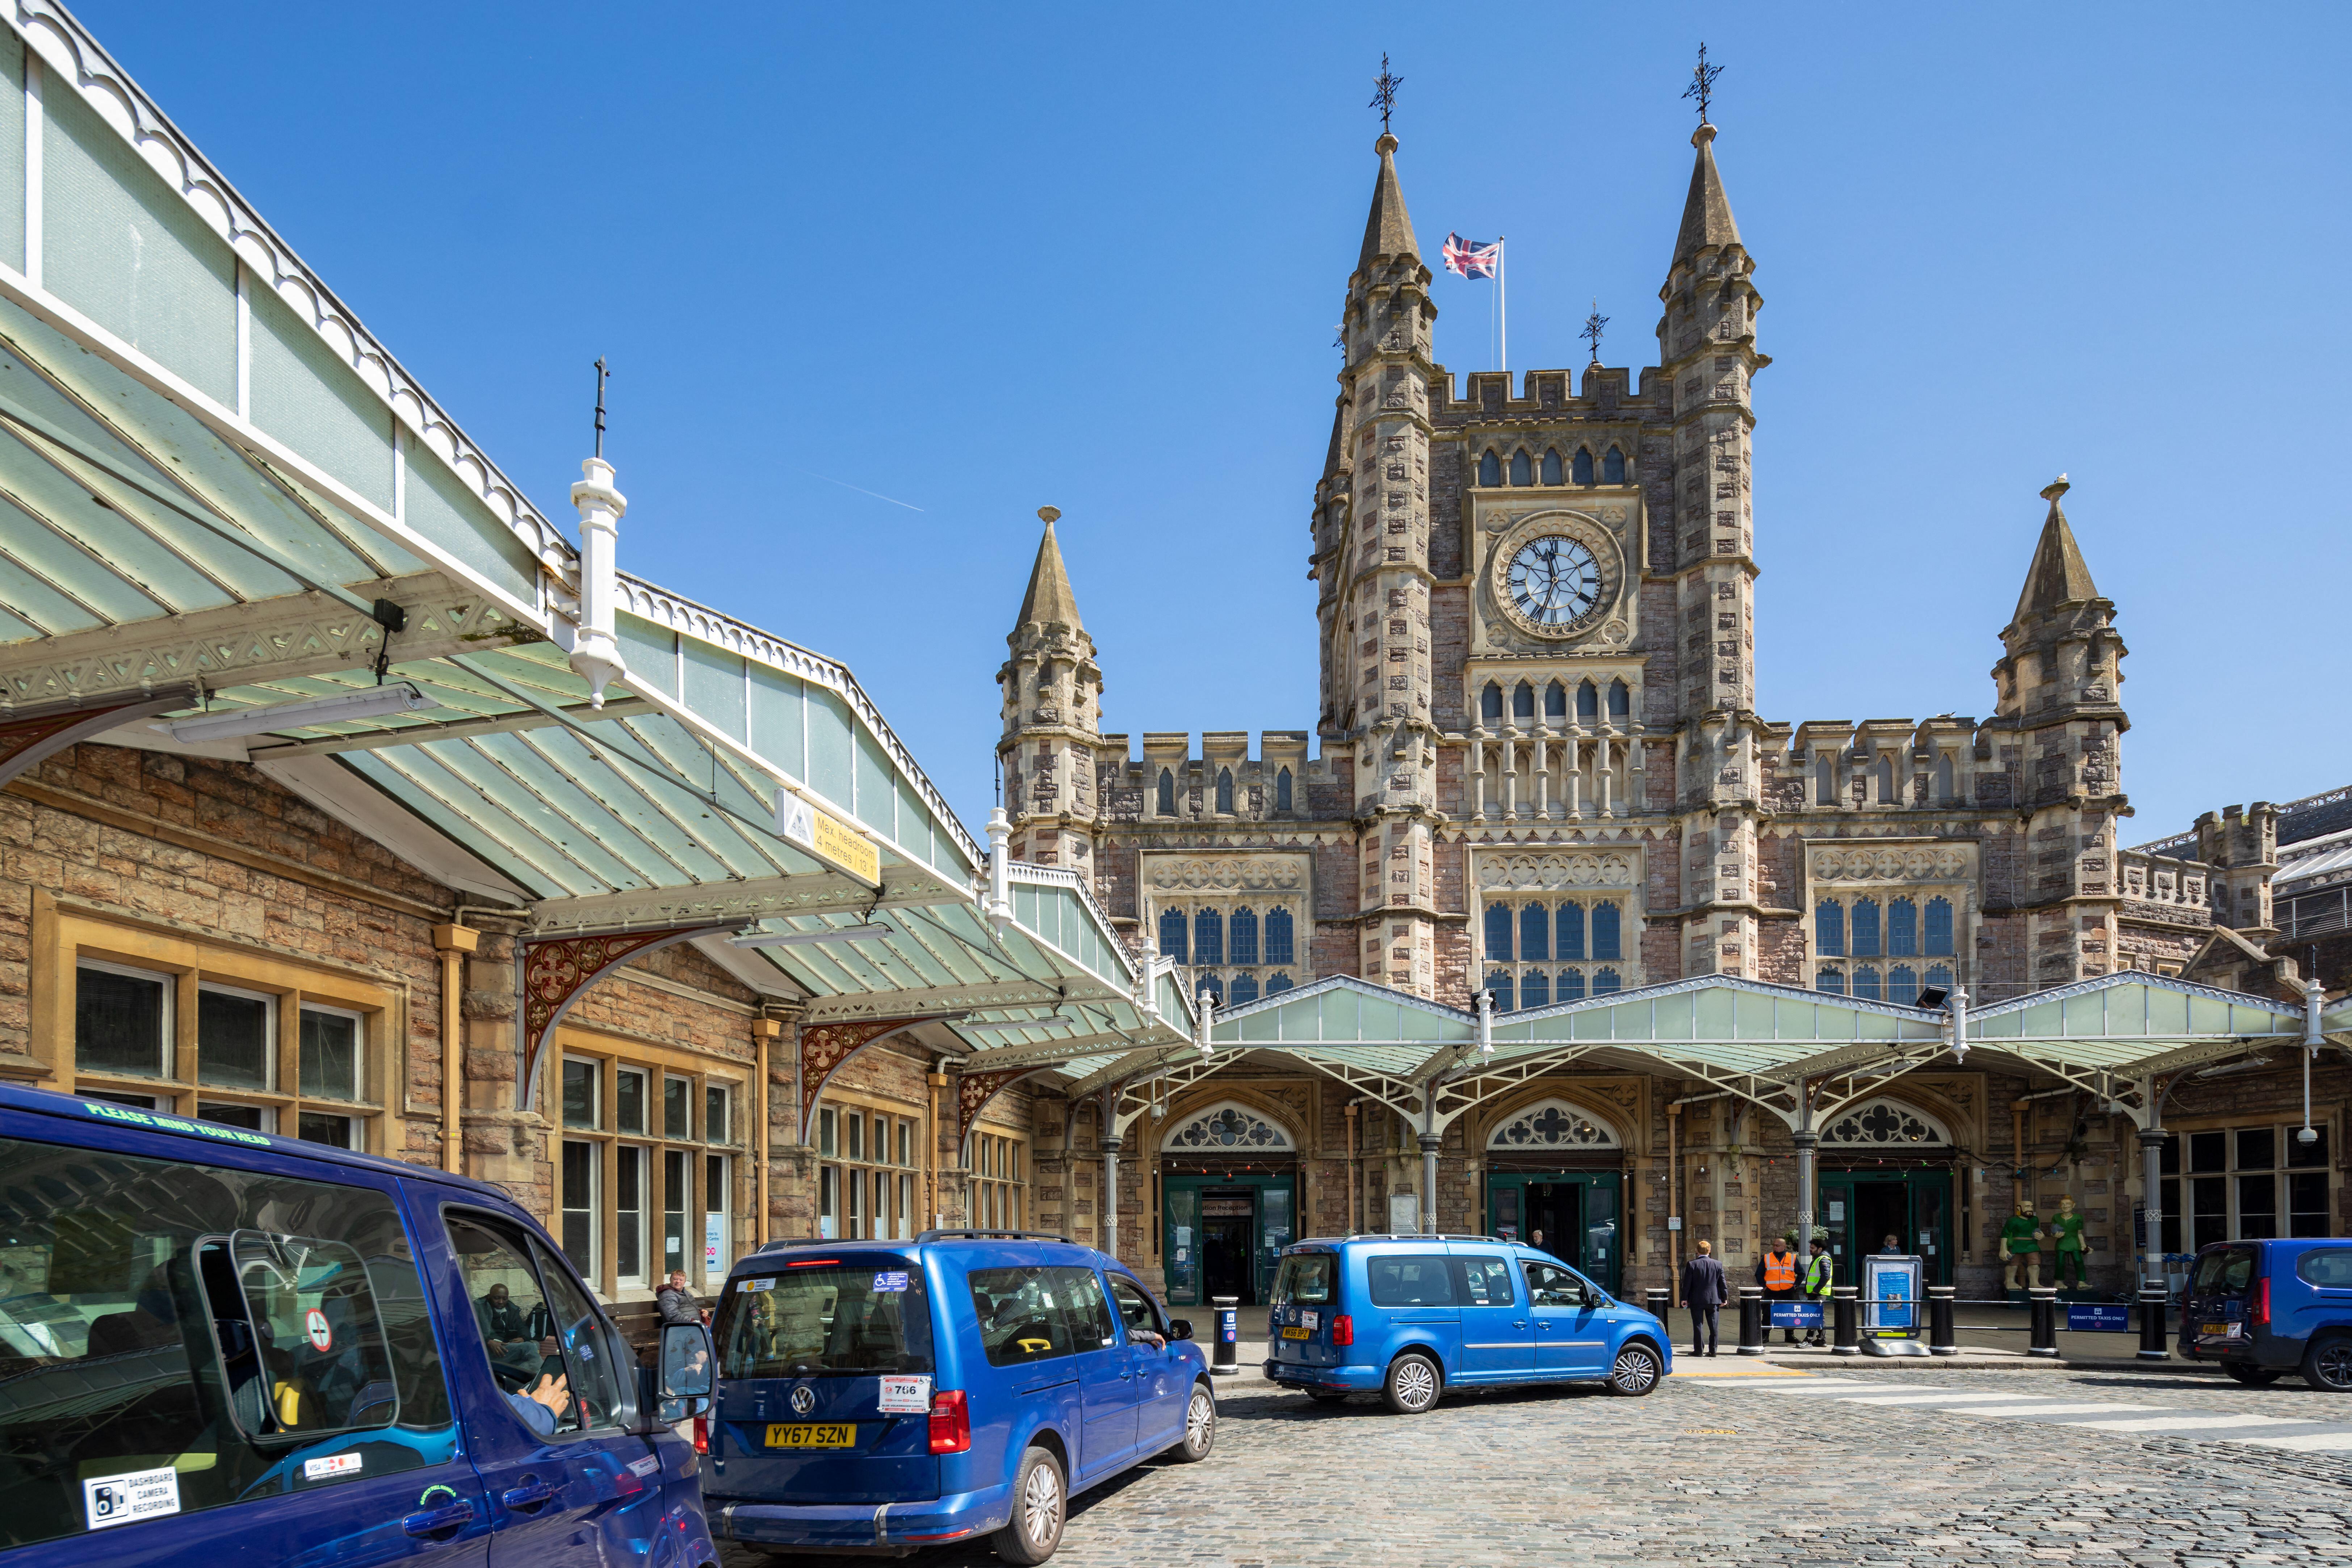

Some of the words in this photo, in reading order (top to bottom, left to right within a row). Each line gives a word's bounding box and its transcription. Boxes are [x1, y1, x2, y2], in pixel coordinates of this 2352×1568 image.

[1568, 604, 1578, 620] V
[818, 817, 836, 839] Max.
[839, 829, 875, 861] headroom
[817, 835, 822, 847] 4
[826, 841, 852, 863] metres
[855, 854, 857, 868] /
[84, 1103, 153, 1125] PLEASE
[151, 1116, 195, 1132] MIND
[193, 1124, 237, 1140] YOUR
[234, 1132, 271, 1146] HEAD
[1284, 1328, 1297, 1337] NK66
[1297, 1329, 1308, 1338] BPZ
[895, 1386, 916, 1394] 766
[773, 1427, 812, 1443] YY67
[816, 1427, 848, 1443] SZN
[129, 1473, 173, 1488] DASHBOARD
[137, 1487, 168, 1499] CAMERA
[133, 1498, 176, 1513] RECORDING
